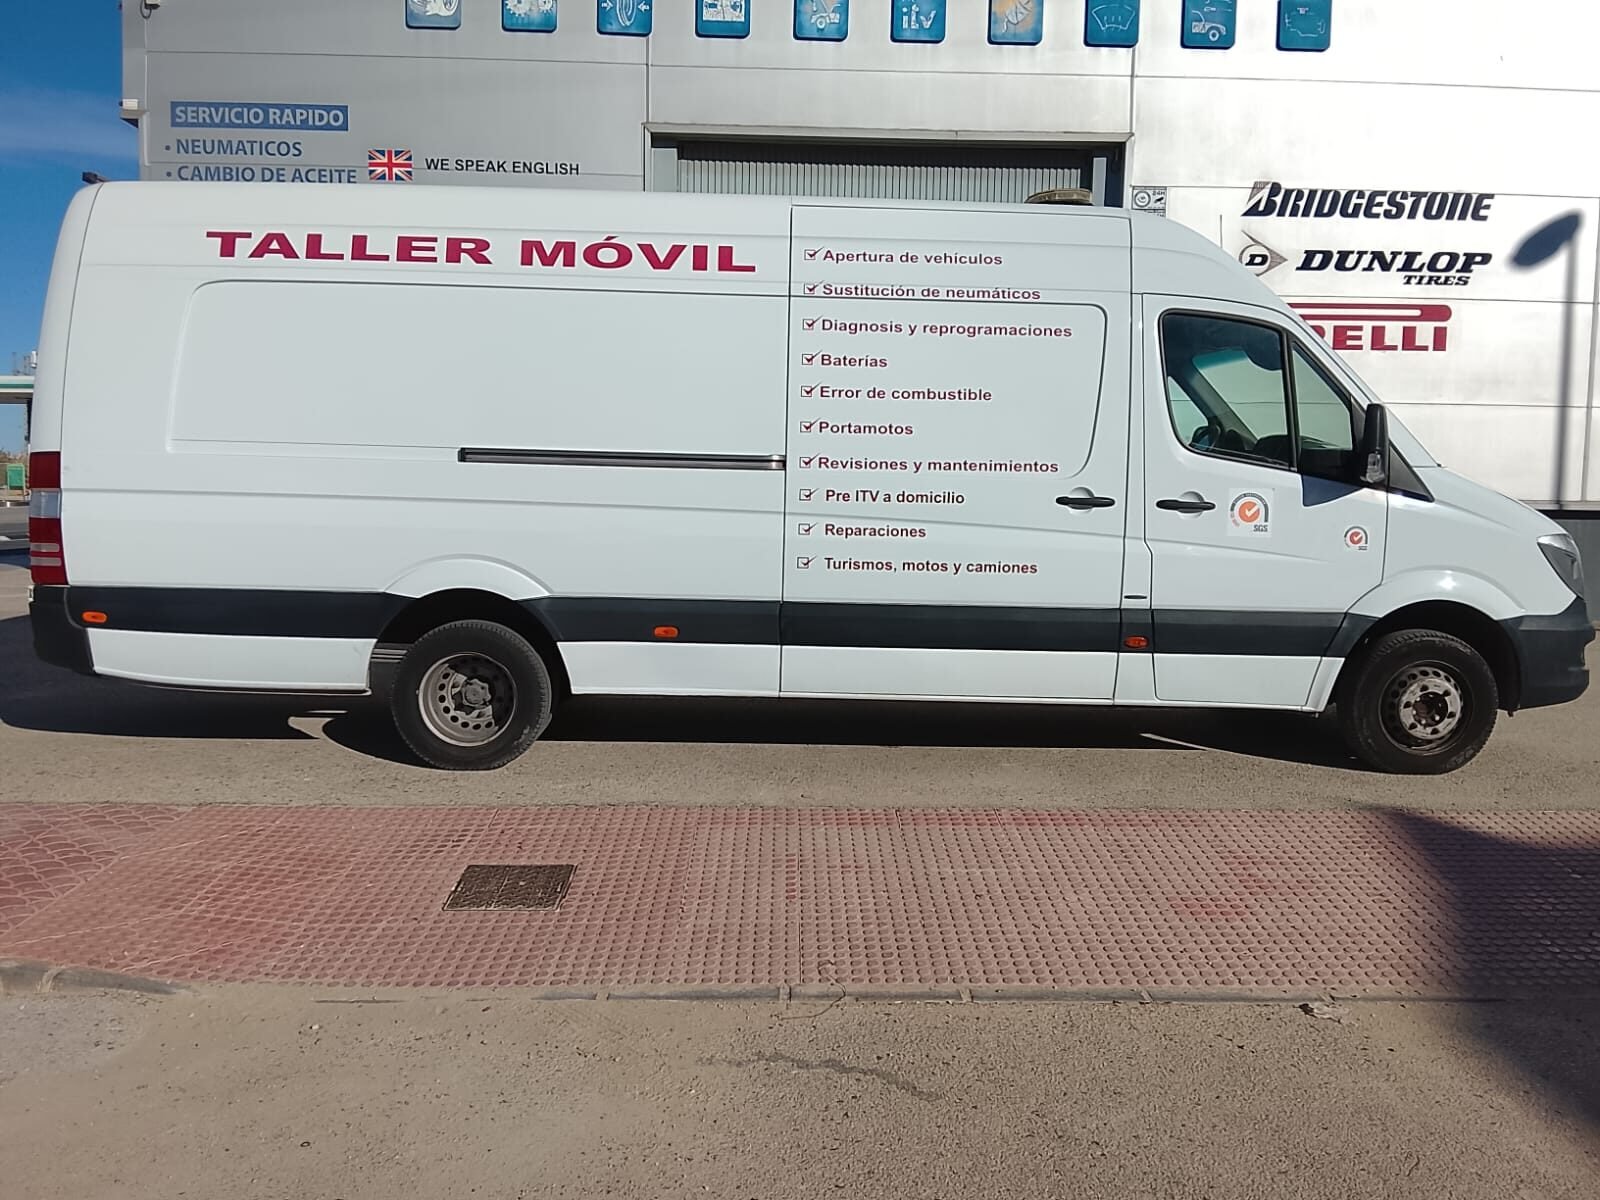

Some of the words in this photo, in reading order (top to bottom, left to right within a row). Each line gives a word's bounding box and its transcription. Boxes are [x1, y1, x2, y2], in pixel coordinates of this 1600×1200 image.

[175, 106, 264, 124] SERVICIO
[269, 109, 344, 127] RAPIDO
[176, 139, 302, 157] NEUMATICOS
[177, 165, 255, 182] CAMBIO
[261, 167, 286, 183] DE
[291, 168, 357, 184] ACEITE
[425, 158, 450, 171] WE
[455, 159, 507, 174] SPEAK
[512, 161, 580, 176] ENGLISH
[1241, 181, 1495, 222] BRIDGESTONE
[206, 231, 493, 265] TALLER
[520, 236, 756, 272] MÓVIL
[823, 249, 894, 264] Apertura
[900, 252, 919, 263] de
[925, 252, 1002, 265] vehículos
[1245, 253, 1269, 266] D
[1295, 250, 1493, 274] DUNLOP
[1403, 274, 1471, 286] TIRES
[822, 283, 915, 297] Sustitución
[921, 286, 940, 298] de
[946, 287, 1041, 300] neumáticos
[822, 319, 903, 336] Diagnosis
[908, 324, 917, 336] y
[923, 324, 1073, 338] reprogramaciones
[821, 354, 888, 367] Baterías
[820, 386, 862, 399] Error
[866, 387, 886, 399] de
[892, 388, 992, 401] combustible
[819, 422, 913, 435] Portamotos
[819, 457, 908, 471] Revisiones
[913, 462, 922, 474] y
[928, 460, 1059, 473] mantenimientos
[826, 490, 850, 502] Pre
[856, 490, 880, 503] ITV
[883, 493, 891, 503] a
[897, 491, 965, 504] domicilio
[825, 524, 927, 539] Reparaciones
[824, 557, 897, 573] Turismos,
[902, 560, 948, 573] motos
[953, 563, 962, 575] y
[966, 561, 1038, 574] camiones
